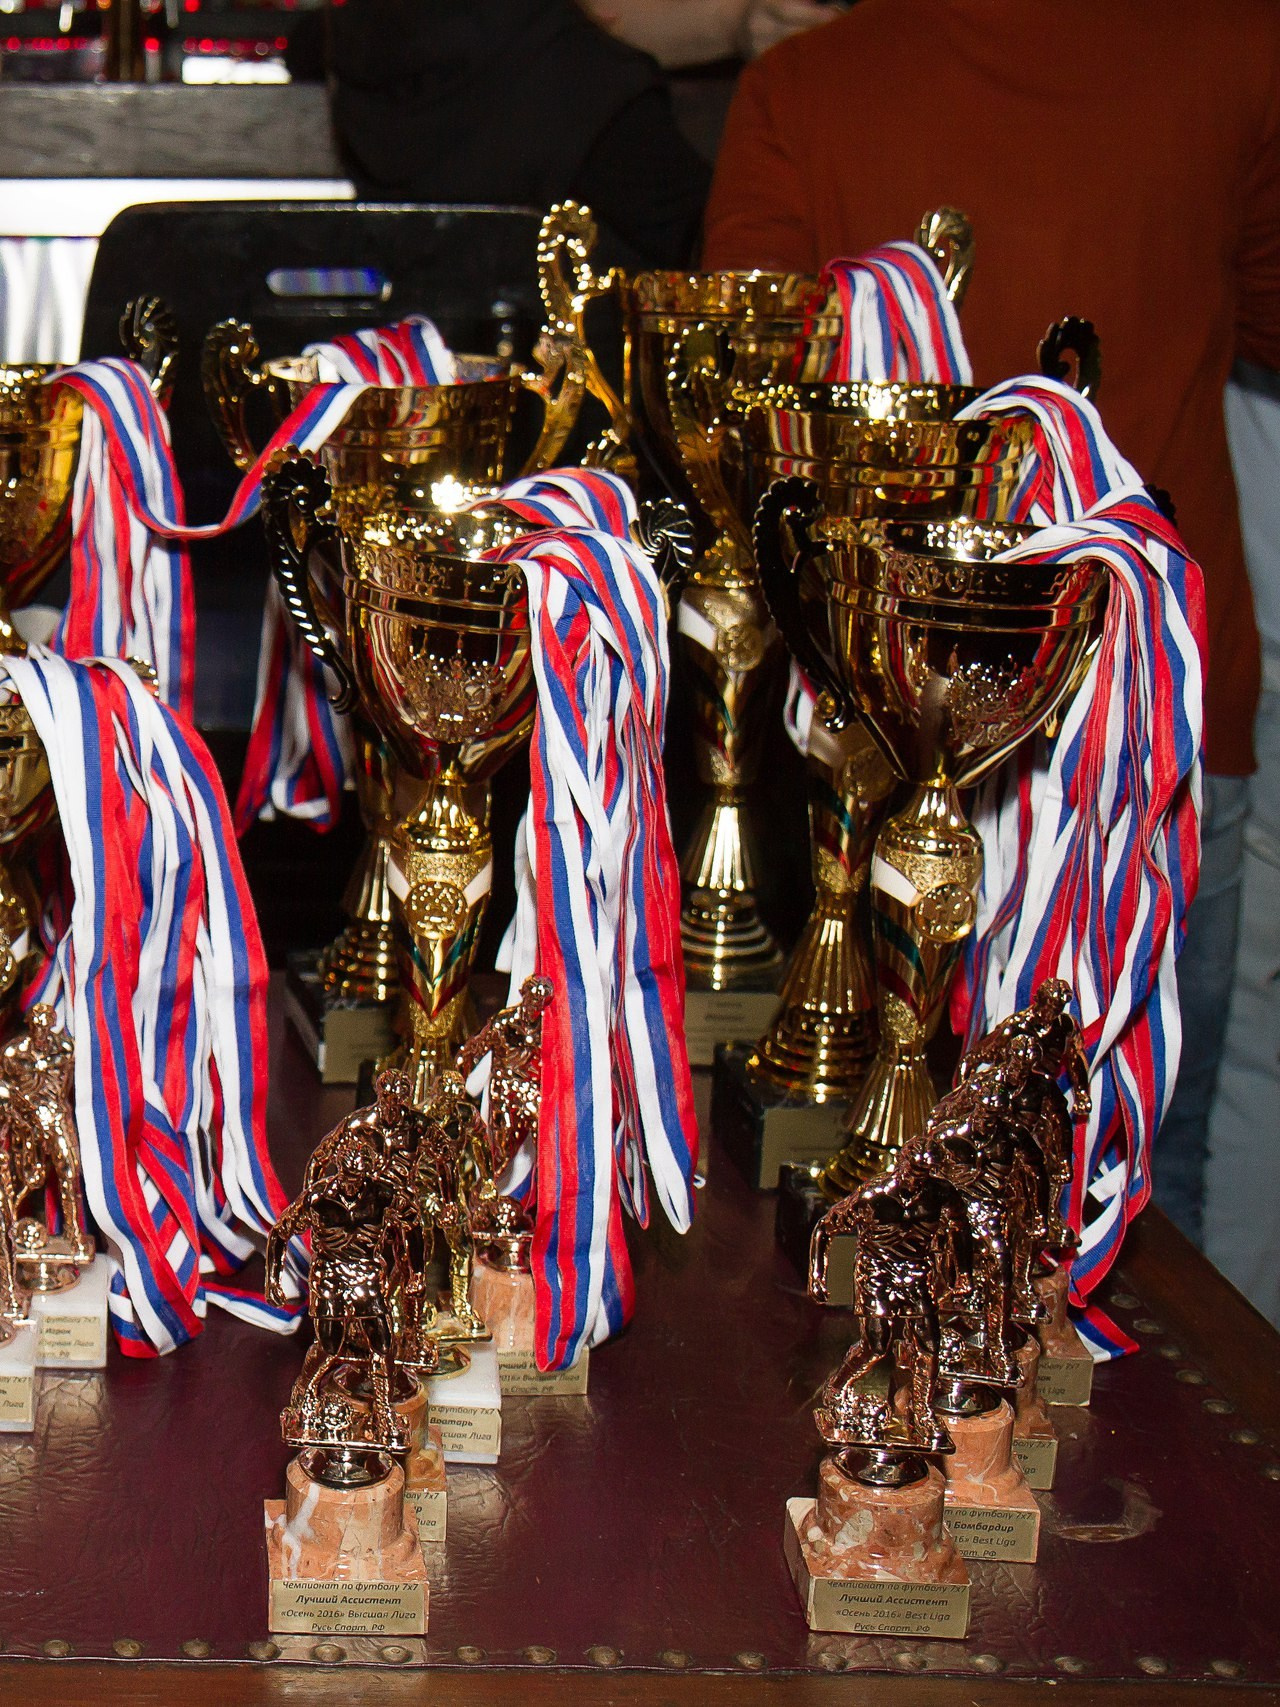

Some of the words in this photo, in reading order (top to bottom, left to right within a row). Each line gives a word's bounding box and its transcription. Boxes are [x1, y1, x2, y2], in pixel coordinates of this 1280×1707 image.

[430, 1417, 473, 1427] Вратарь
[469, 1431, 492, 1440] Лига
[969, 1509, 1013, 1519] футболу
[953, 1521, 1014, 1533] Бомбардир
[972, 1536, 993, 1544] Best
[996, 1537, 1017, 1547] Liga
[282, 1581, 339, 1590] Чемпионат
[355, 1582, 400, 1591] футболу
[827, 1581, 885, 1590] Чемпионат
[901, 1583, 947, 1593] футболу
[295, 1595, 338, 1604] Лучший
[340, 1596, 402, 1605] Ассистент
[839, 1594, 883, 1604] Лучший
[885, 1596, 949, 1606] Ассистент
[281, 1609, 315, 1618] «Осень
[317, 1609, 345, 1618] 2016»
[348, 1610, 389, 1619] Высшая
[390, 1610, 416, 1619] Лига
[836, 1609, 871, 1618] «Осень
[873, 1610, 902, 1619] 2016»
[904, 1611, 927, 1620] Best
[929, 1612, 951, 1622] Liga
[311, 1623, 332, 1632] Русь
[334, 1623, 368, 1632] Спорт.
[371, 1623, 385, 1631] РФ
[854, 1622, 875, 1631] Русь
[915, 1624, 931, 1632] РФ
